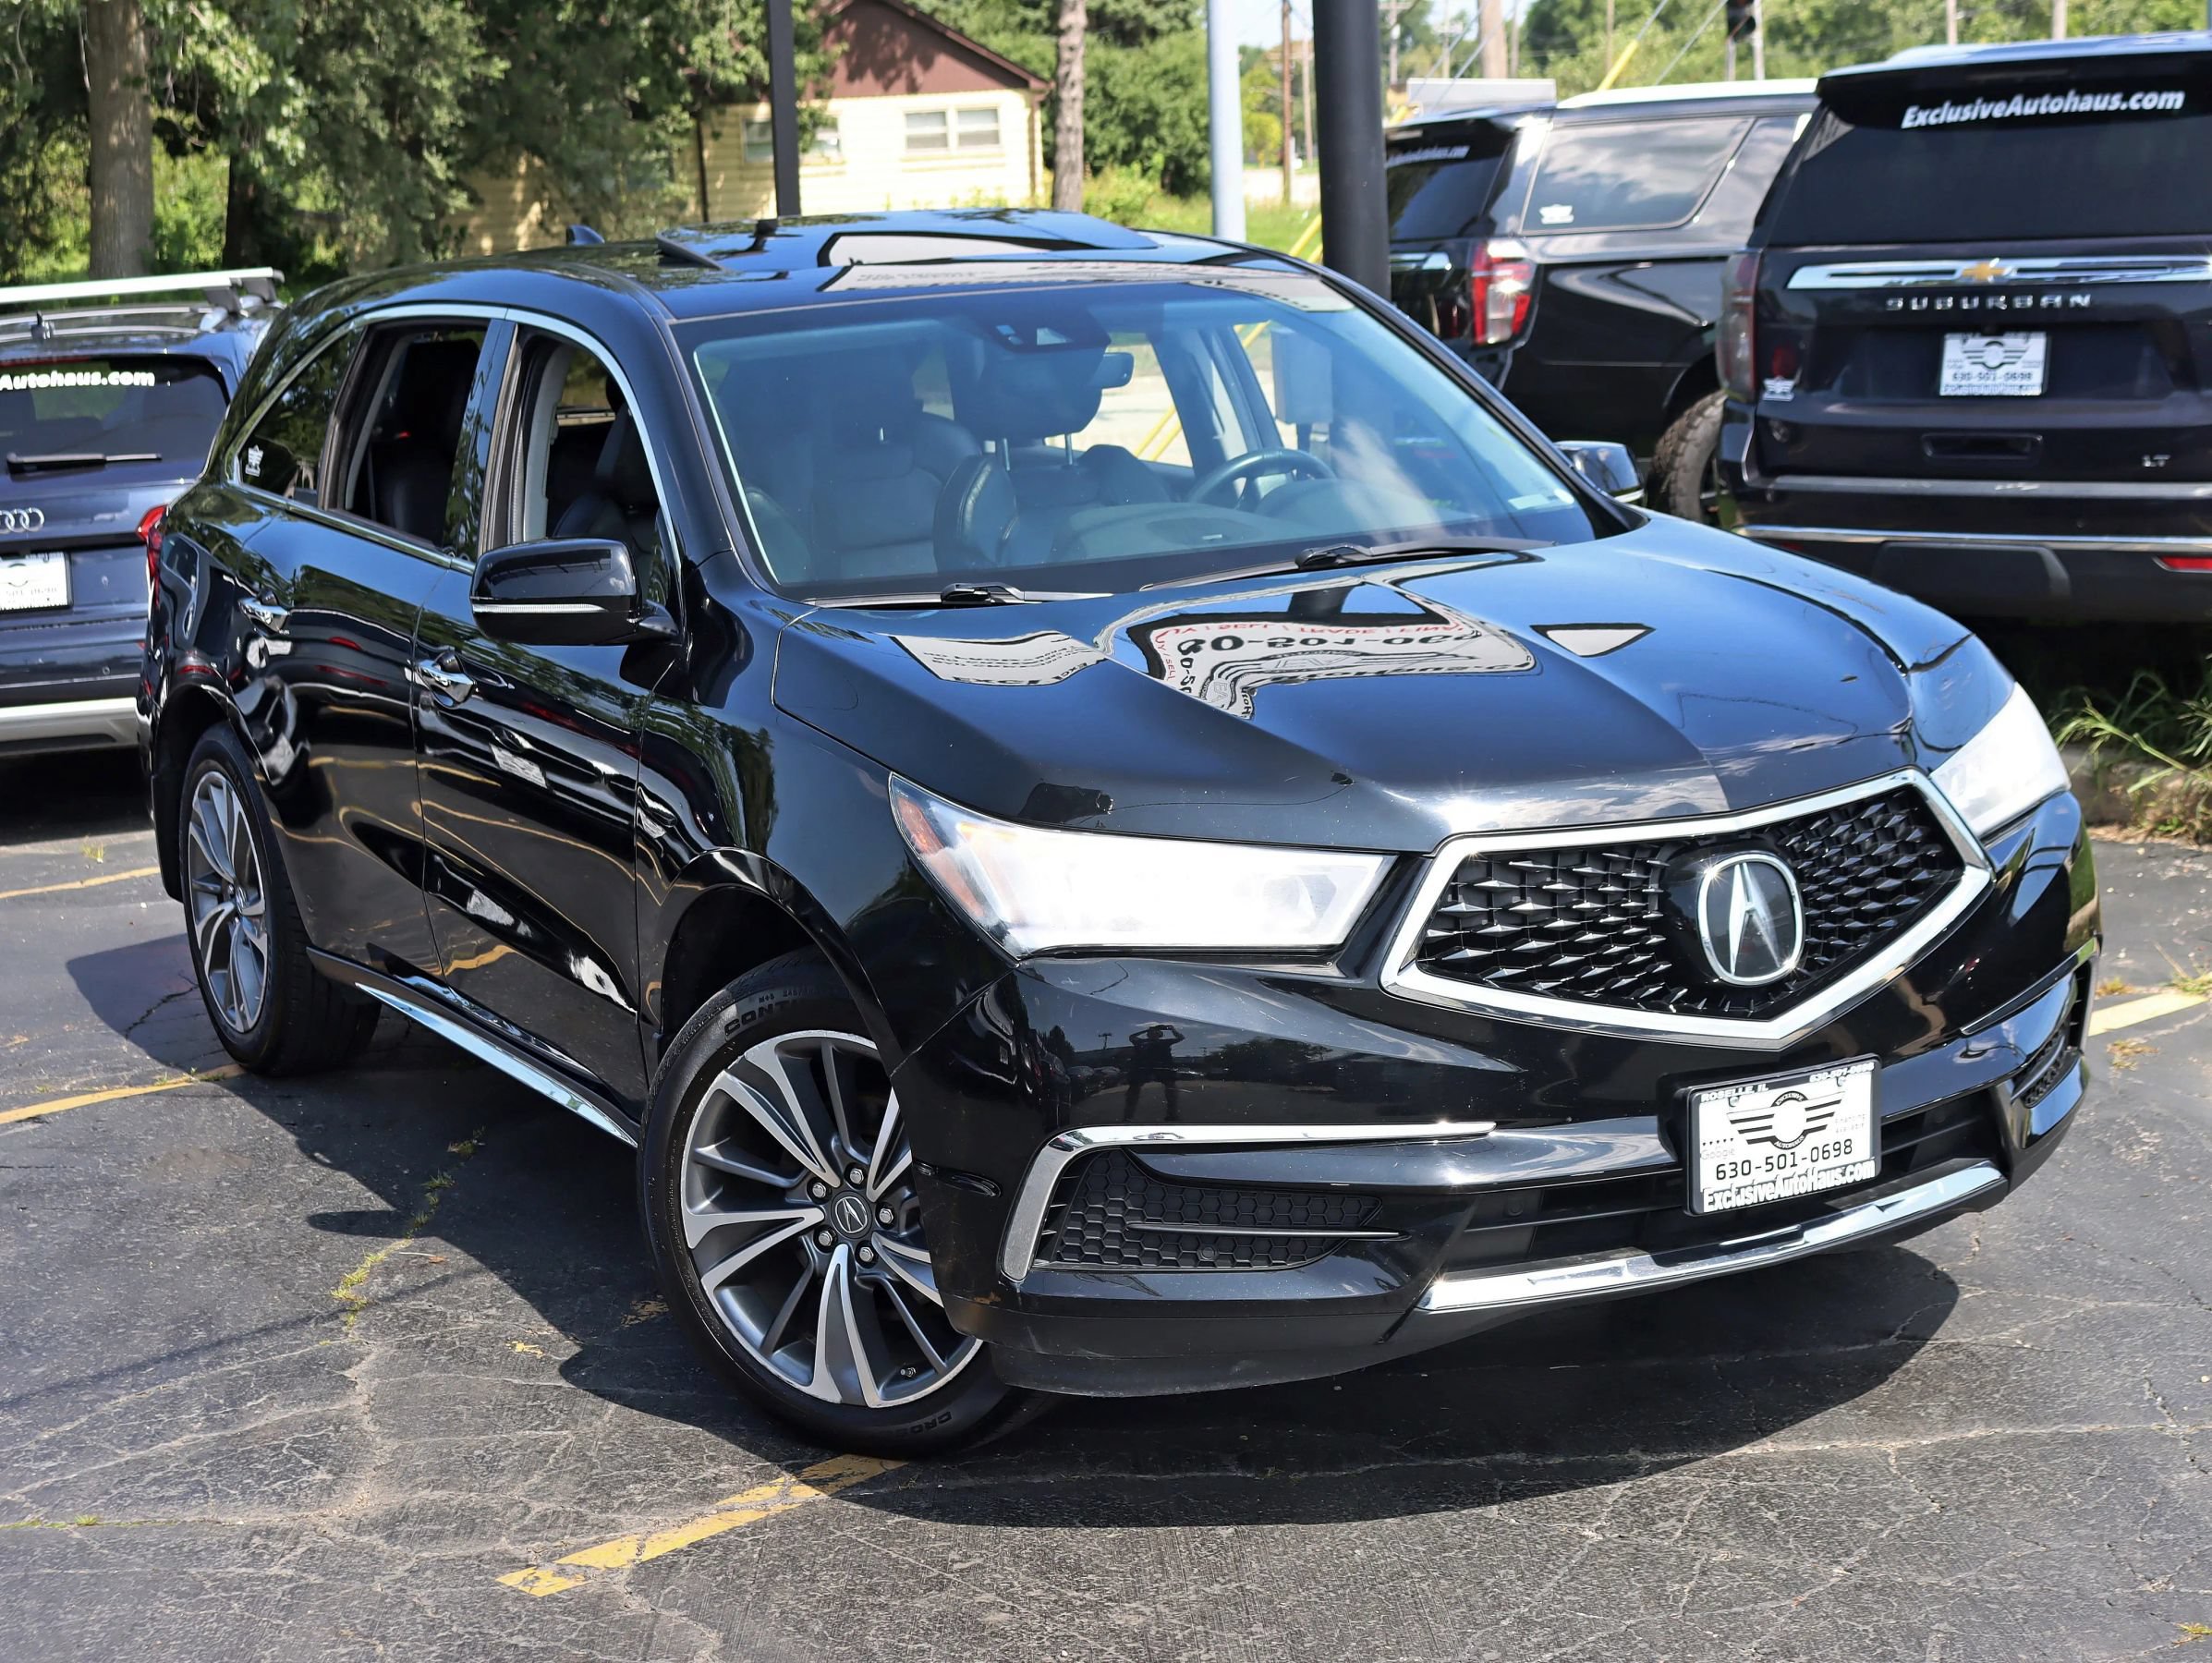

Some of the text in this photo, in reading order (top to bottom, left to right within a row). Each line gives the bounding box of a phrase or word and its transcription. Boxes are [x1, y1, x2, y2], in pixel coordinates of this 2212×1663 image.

[1901, 90, 2185, 129] ExclusiveAutohaus.com
[1887, 293, 2092, 310] SUBURBAN
[2142, 454, 2171, 467] LT
[1757, 1083, 1769, 1093] IL
[1716, 1138, 1853, 1181] 630-501-0698
[1703, 1159, 1876, 1213] ExclusiveAutoHaus.com
